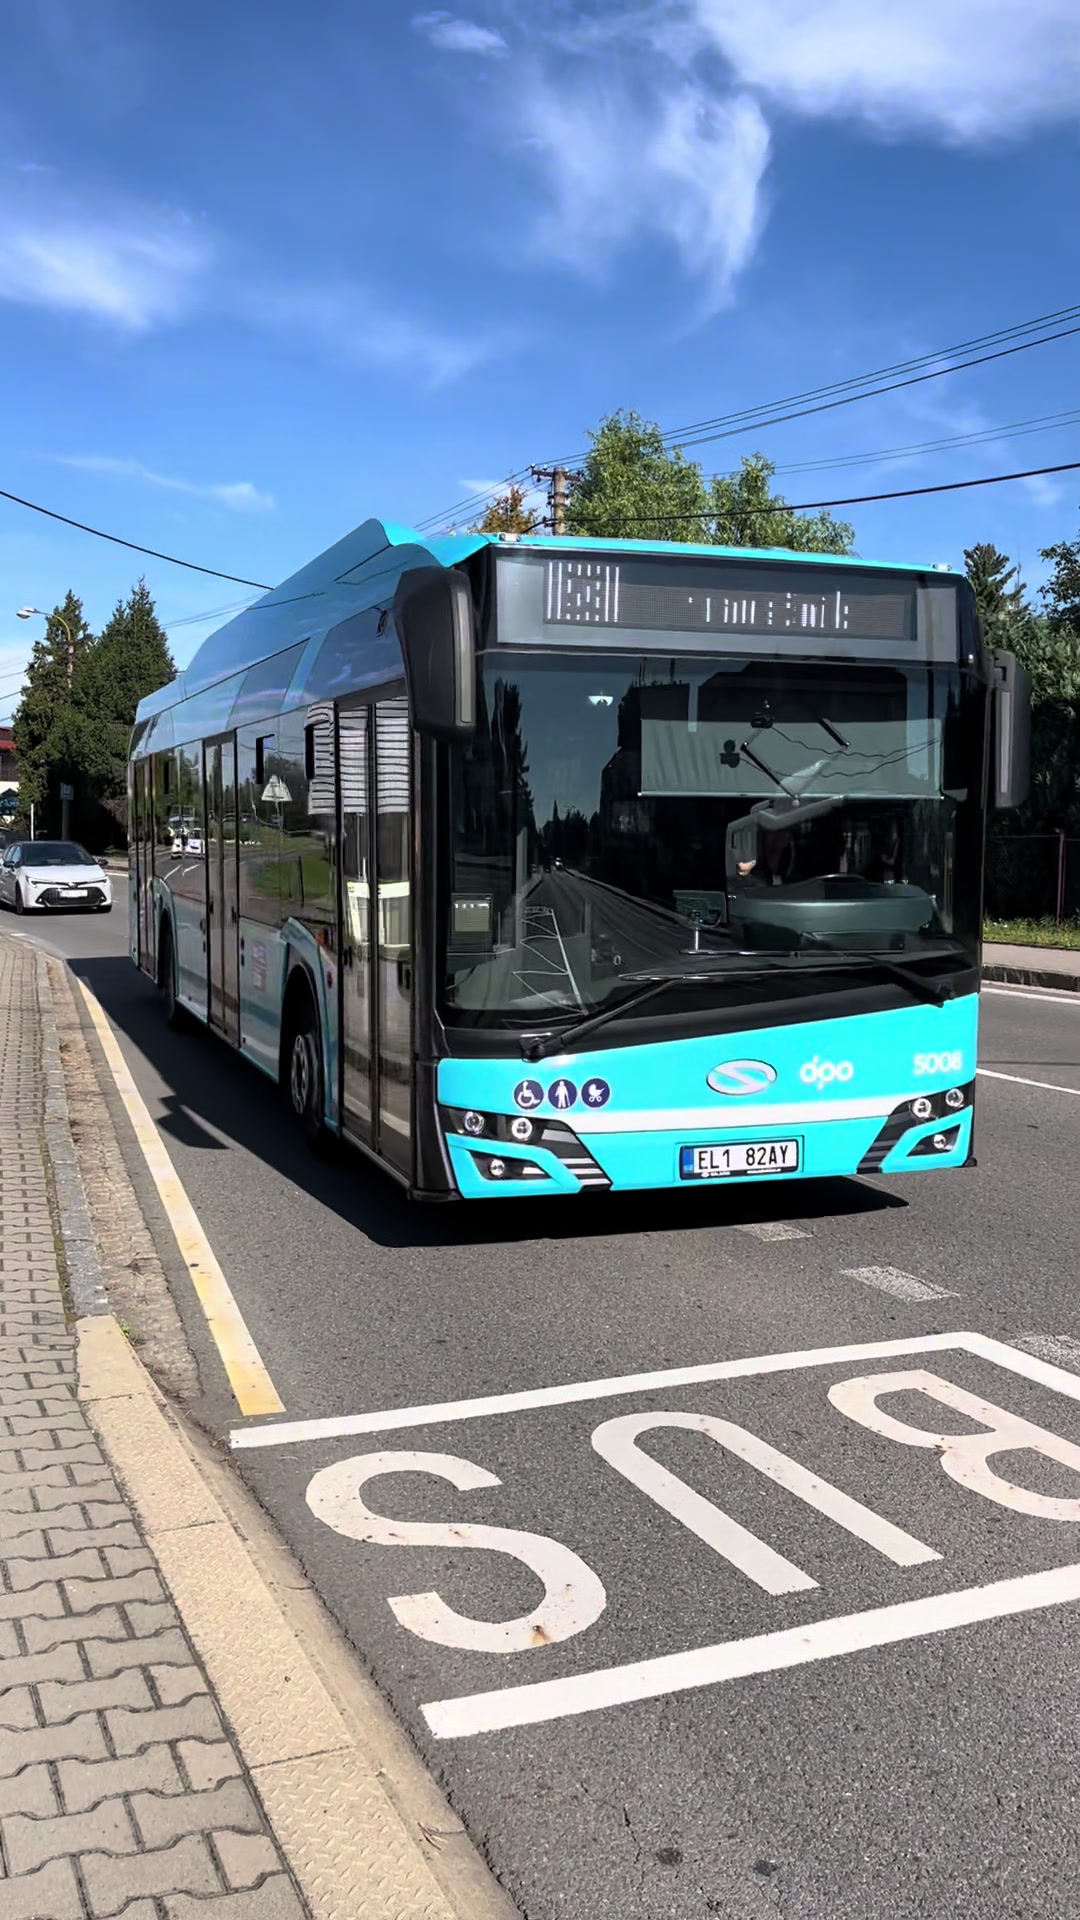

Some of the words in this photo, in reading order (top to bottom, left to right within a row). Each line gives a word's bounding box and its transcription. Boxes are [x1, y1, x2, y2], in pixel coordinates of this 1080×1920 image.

[799, 1054, 854, 1091] dpo
[913, 1051, 963, 1076] 5008
[698, 1149, 730, 1170] EL1
[745, 1145, 789, 1167] 82AY
[305, 1369, 1080, 1653] BUS
